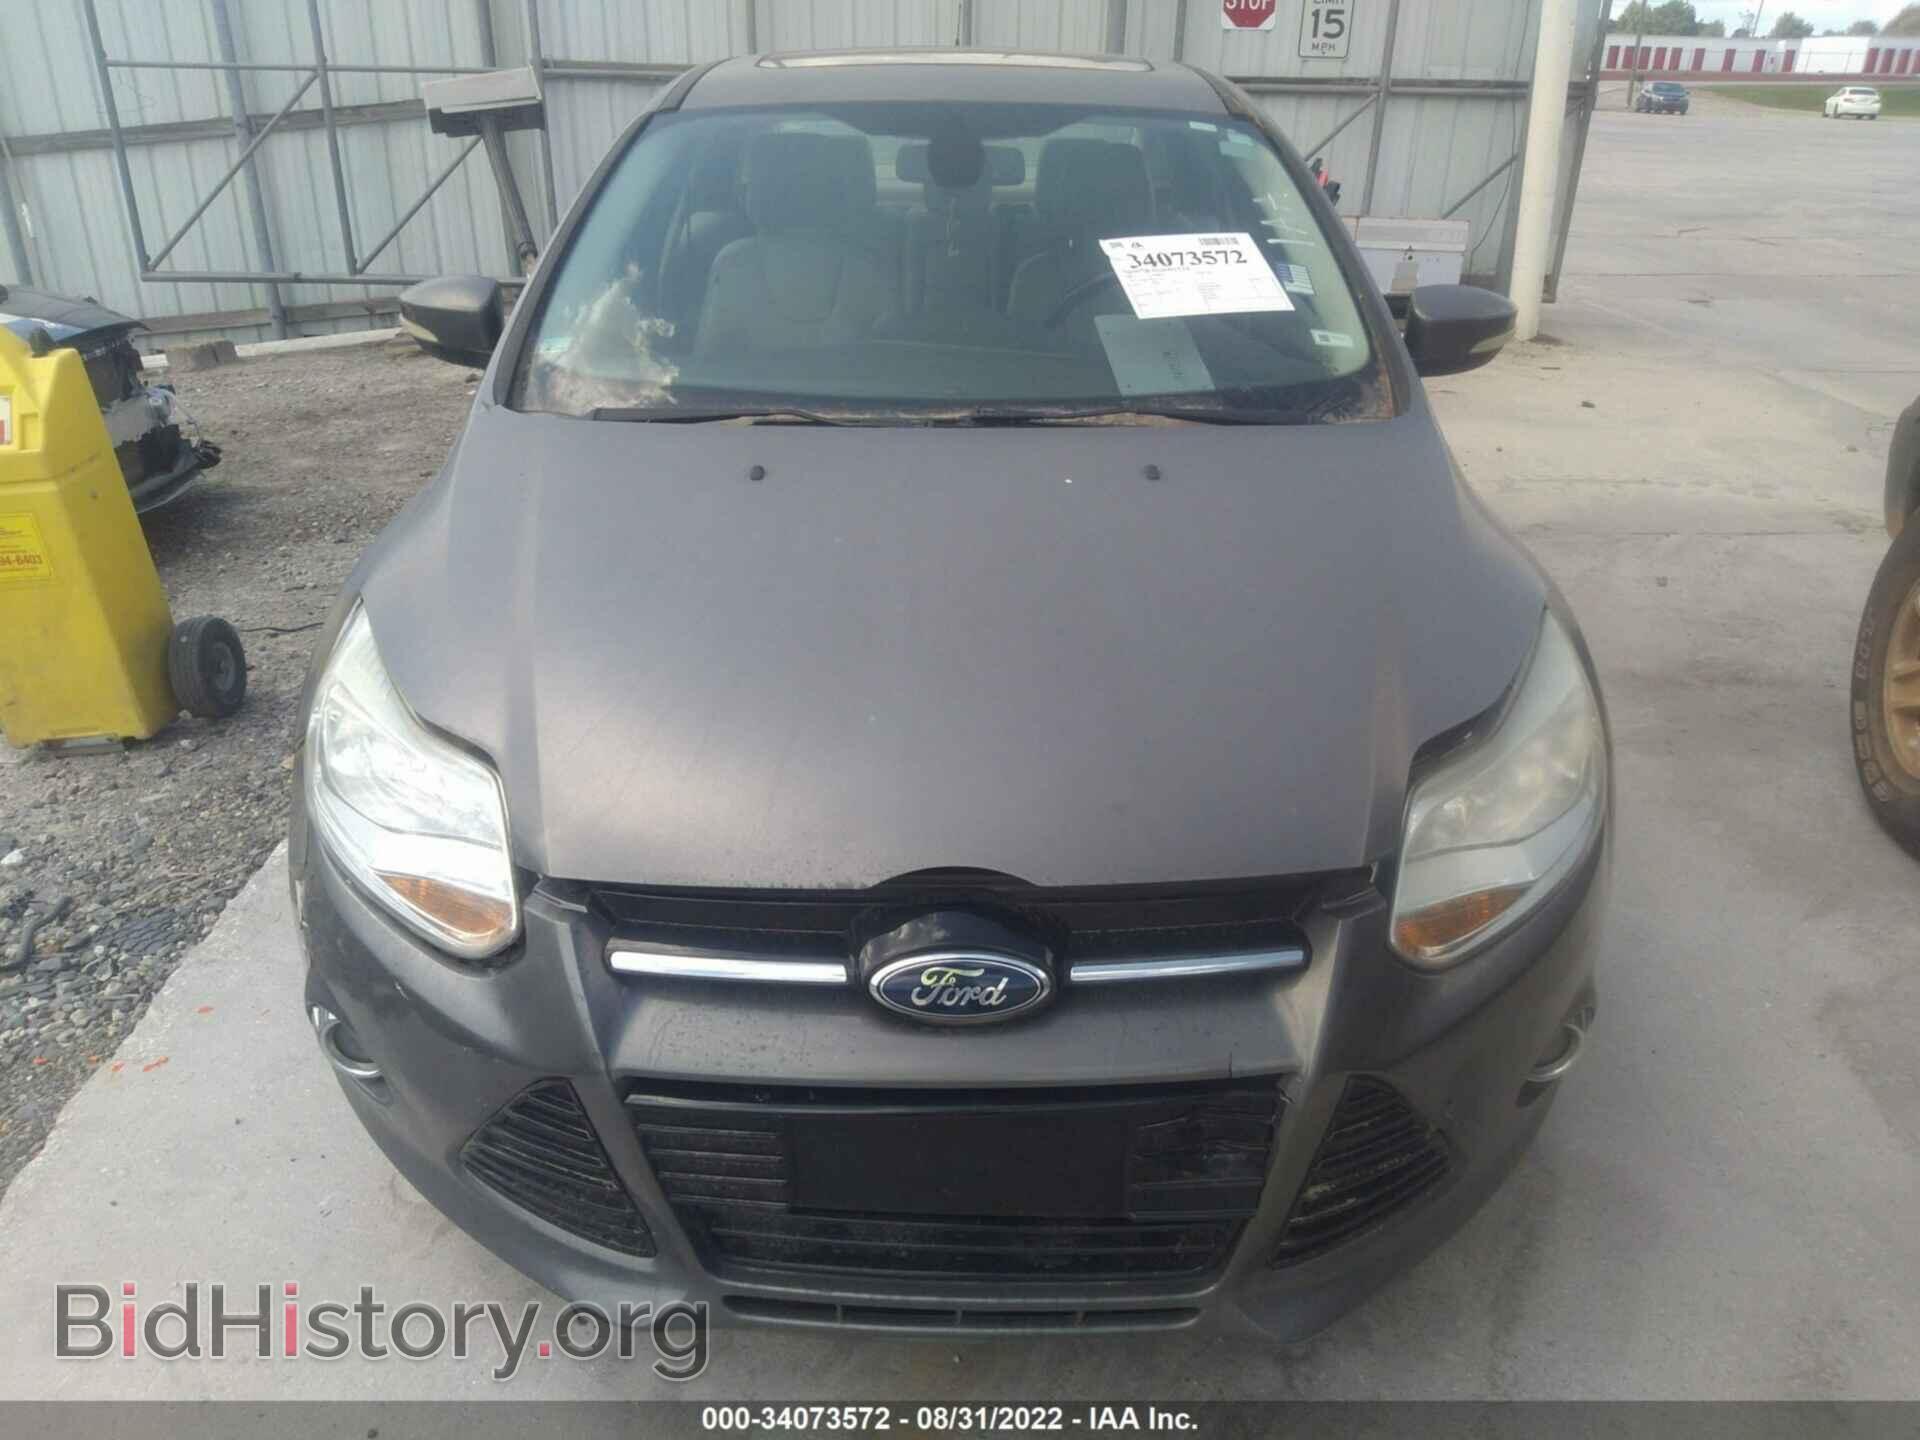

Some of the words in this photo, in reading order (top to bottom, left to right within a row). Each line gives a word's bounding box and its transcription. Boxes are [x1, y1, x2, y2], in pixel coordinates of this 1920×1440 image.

[1312, 9, 1346, 39] 15
[1312, 42, 1336, 51] MPH
[1126, 250, 1247, 269] 34073572
[911, 966, 1008, 1006] Ford
